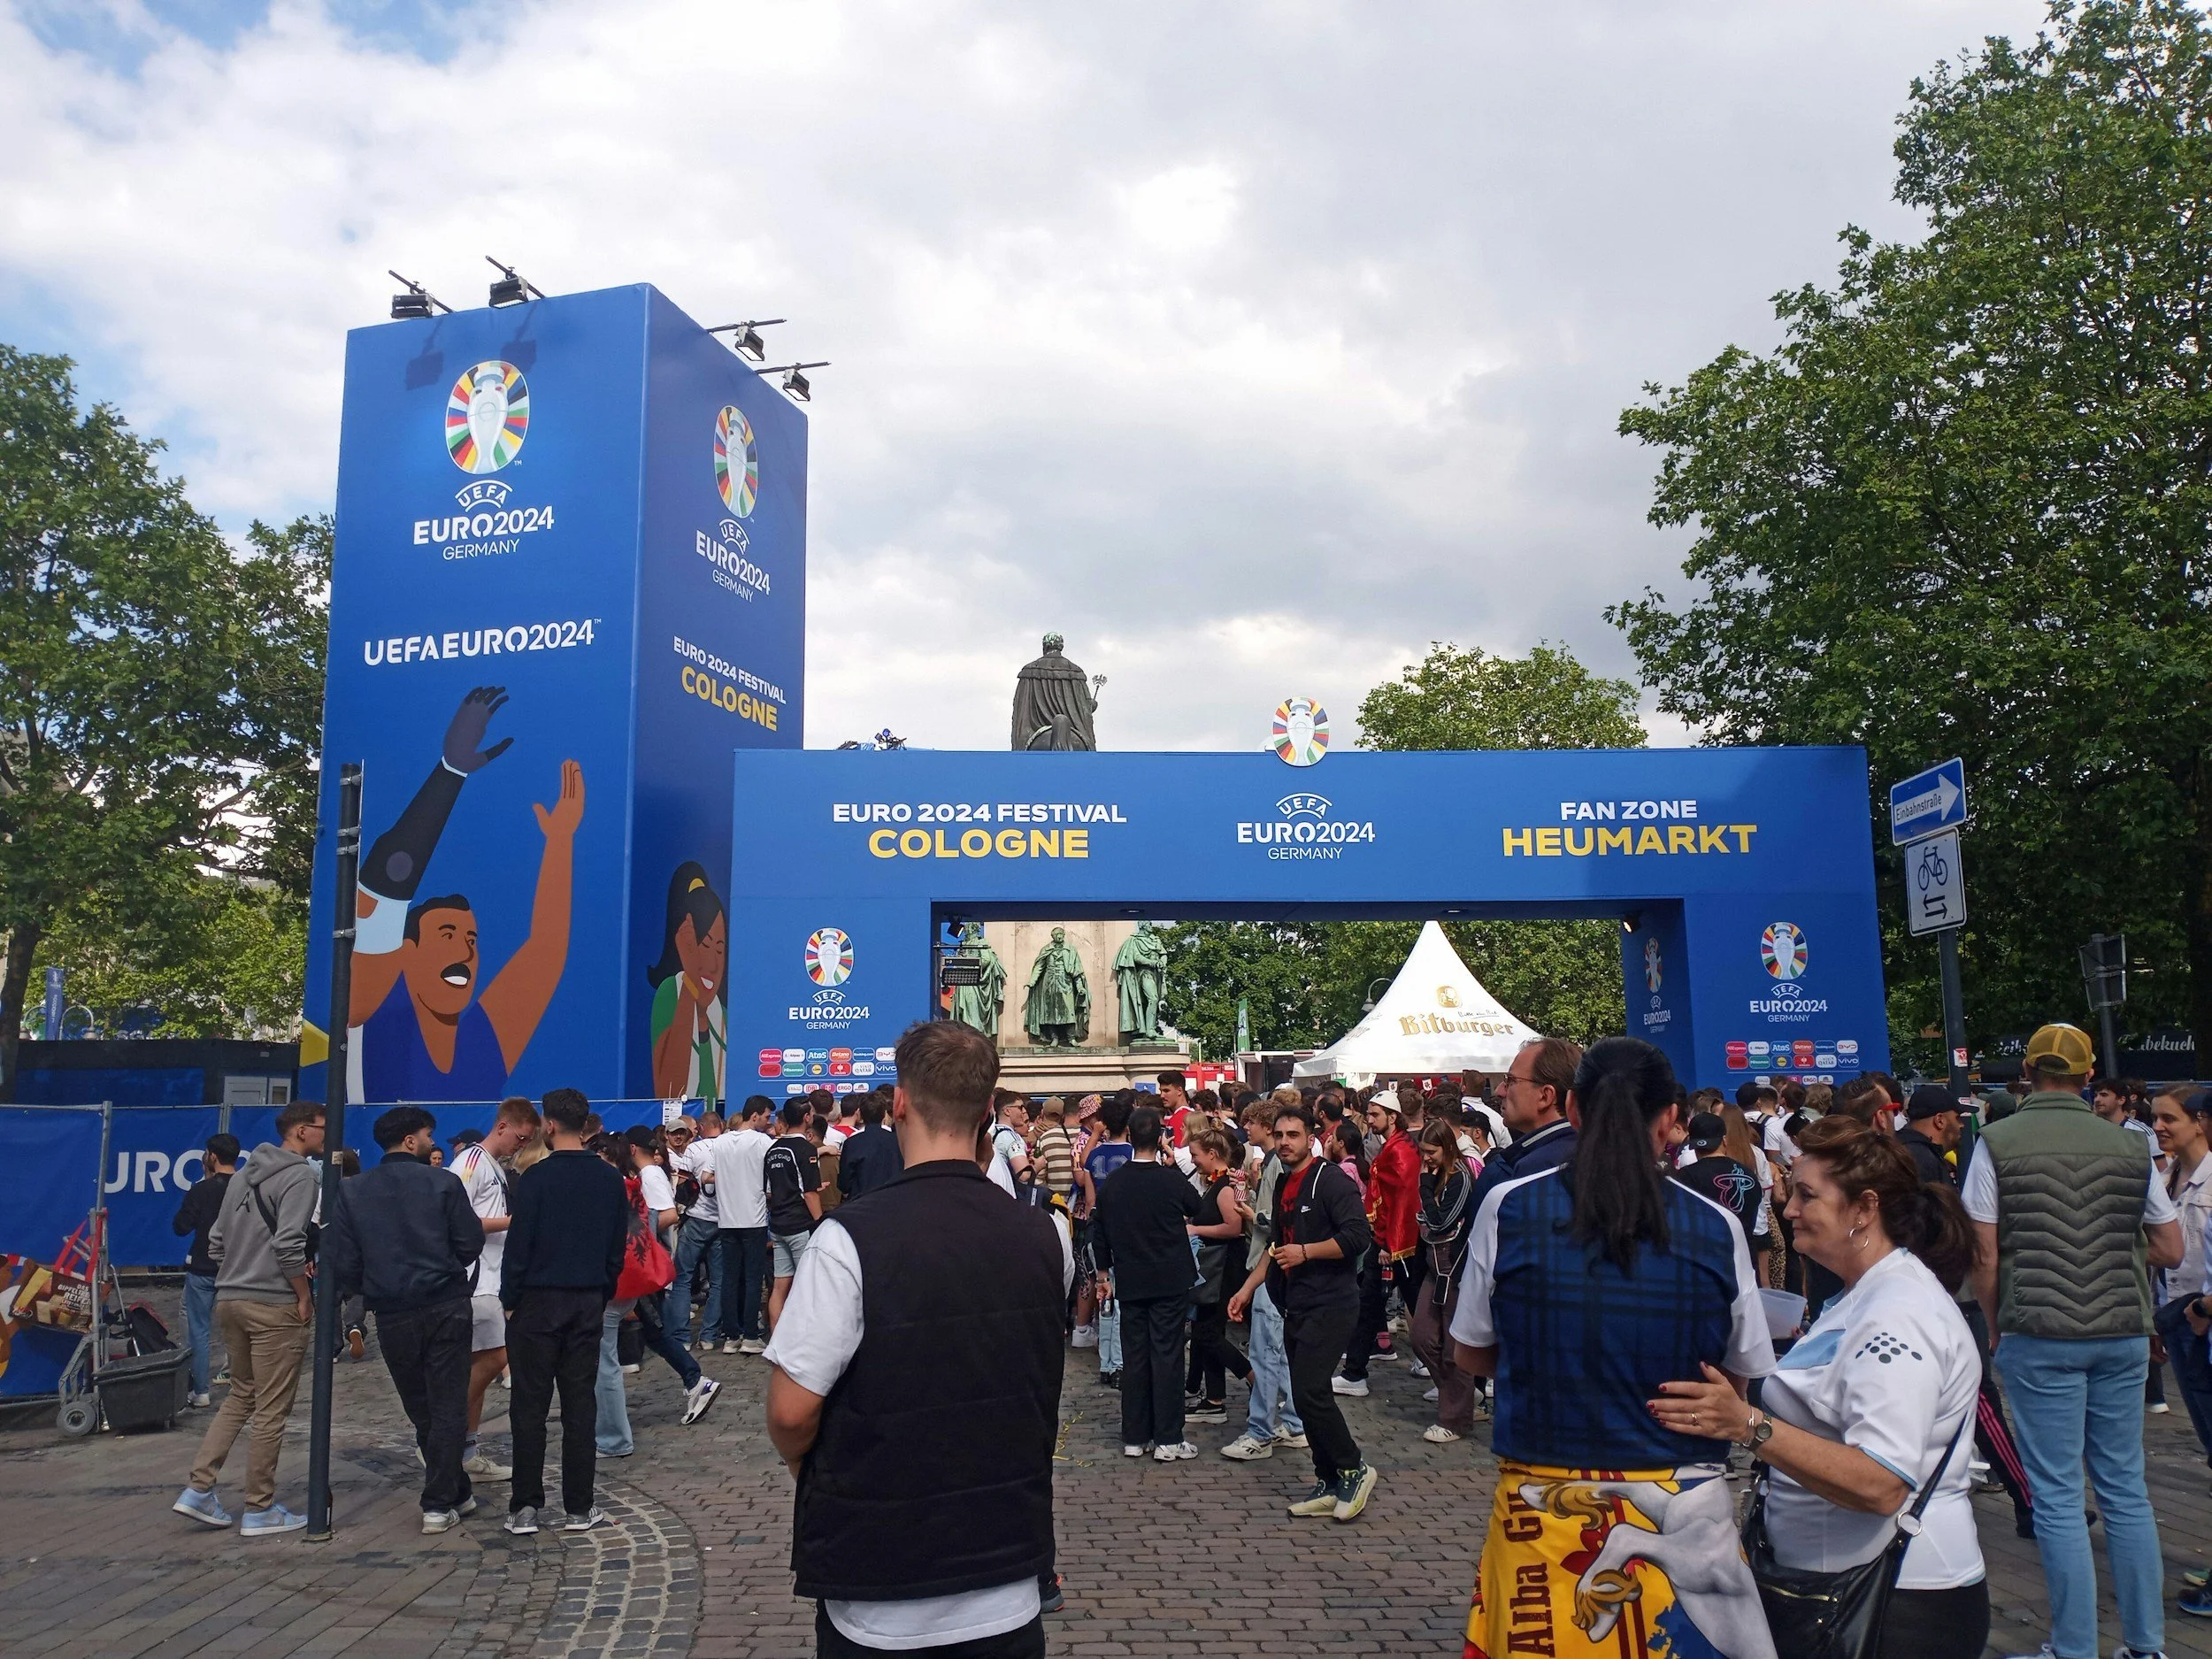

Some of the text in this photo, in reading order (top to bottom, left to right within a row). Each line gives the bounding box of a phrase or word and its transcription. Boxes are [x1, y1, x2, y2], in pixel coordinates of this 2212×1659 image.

[457, 484, 507, 507] UEFA
[413, 505, 555, 545] EURO2024
[720, 523, 749, 552] UEFA
[442, 538, 520, 560] GERMANY
[695, 529, 771, 595] EURO2024
[712, 569, 754, 603] GERMANY
[673, 635, 787, 704] EURO 2024 FESTIVAL
[681, 665, 778, 731] COLOGNE
[833, 803, 1127, 823] EURO 2024 FESTIVAL
[1279, 797, 1327, 816] UEFA
[1560, 800, 1698, 820] FAN ZONE
[1896, 793, 1942, 821] Einbahnstraße
[868, 828, 1089, 858] COLOGNE
[1237, 821, 1376, 843] EURO2024
[1502, 825, 1757, 856] HEUMARKT
[1268, 847, 1343, 860] GERMANY
[814, 992, 843, 1003] UEFA
[1772, 985, 1801, 996] UEFA
[789, 1006, 871, 1020] EURO2024
[1749, 999, 1828, 1013] EURO2024
[806, 1021, 851, 1030] GERMANY
[1398, 1012, 1515, 1037] Bitburger
[1767, 1014, 1810, 1023] GERMANY
[1508, 1563, 1555, 1657] Alba
